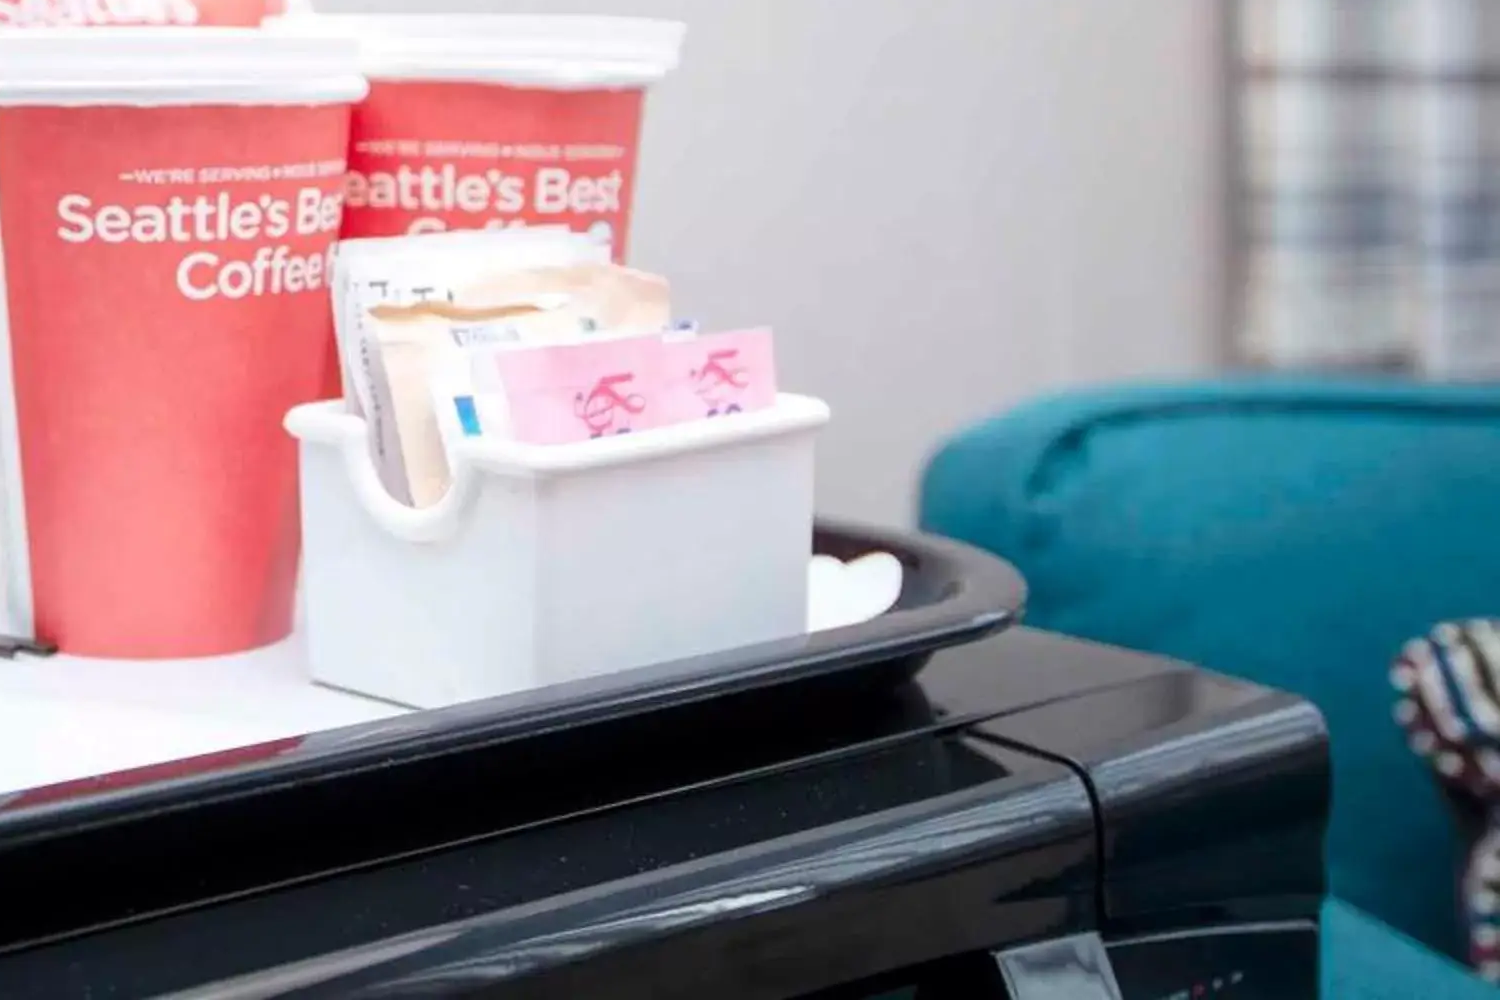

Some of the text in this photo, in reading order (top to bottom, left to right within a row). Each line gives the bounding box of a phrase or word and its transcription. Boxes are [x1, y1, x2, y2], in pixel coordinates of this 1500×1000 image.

[57, 186, 342, 242] Seattle's Be
[347, 164, 525, 212] eattle's
[534, 168, 622, 213] Best
[176, 246, 322, 300] Coffee
